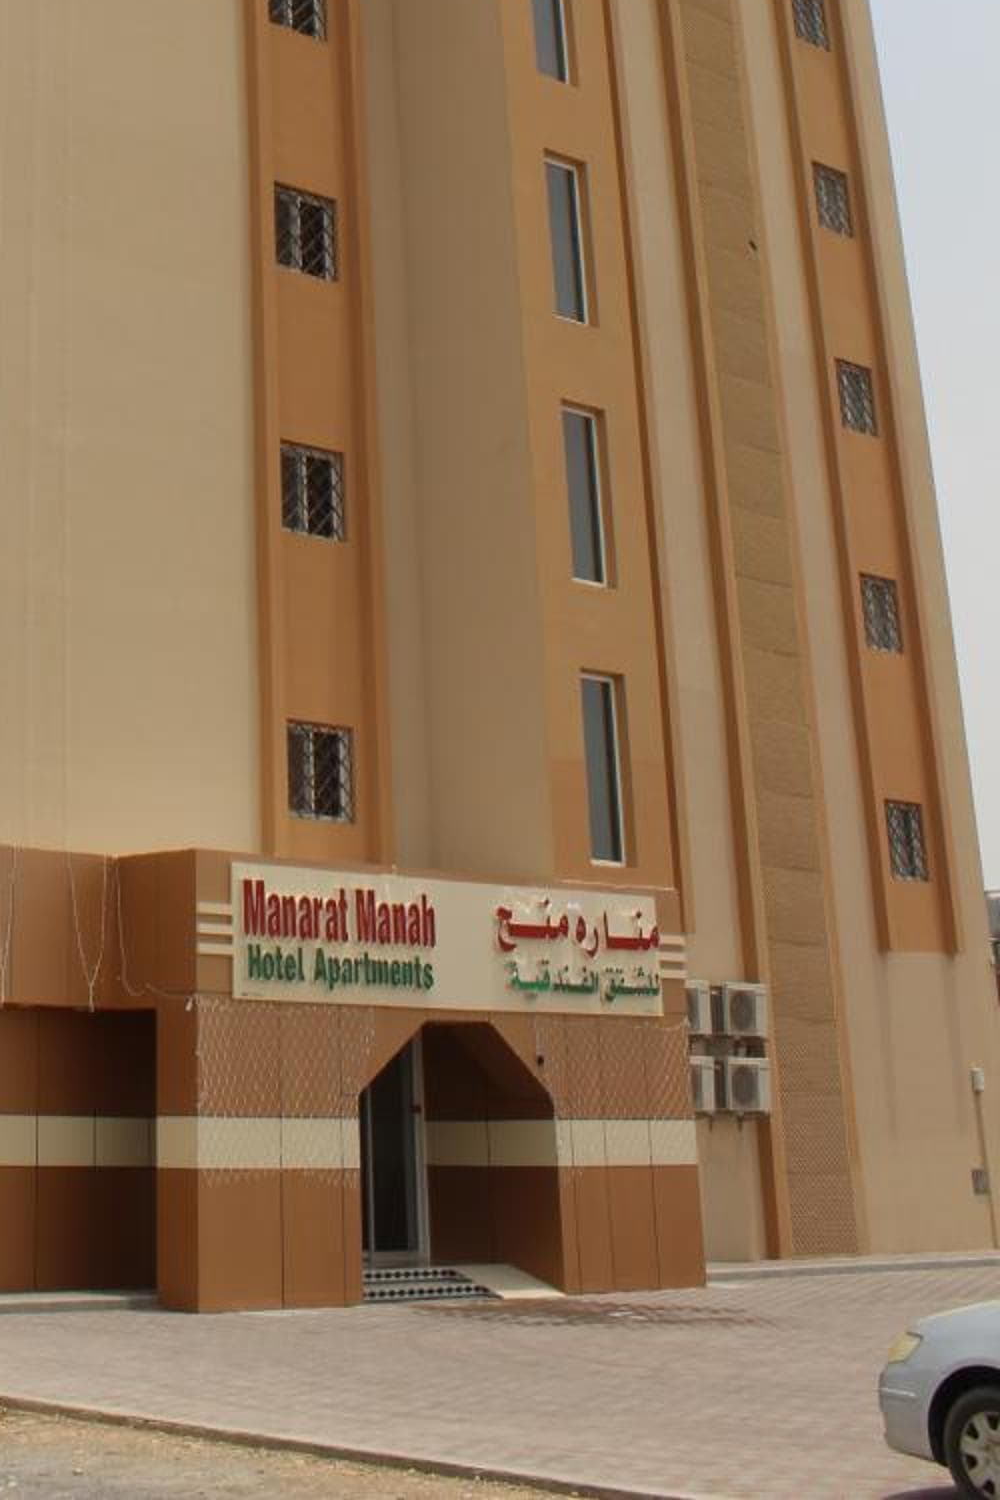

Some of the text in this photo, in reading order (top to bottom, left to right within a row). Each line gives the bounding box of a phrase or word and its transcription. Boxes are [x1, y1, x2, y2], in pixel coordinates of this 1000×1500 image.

[243, 879, 436, 948] Manarat Manah
[496, 898, 569, 951] منح
[247, 944, 434, 991] Hotel Apartments
[507, 959, 599, 995] الفندقية
